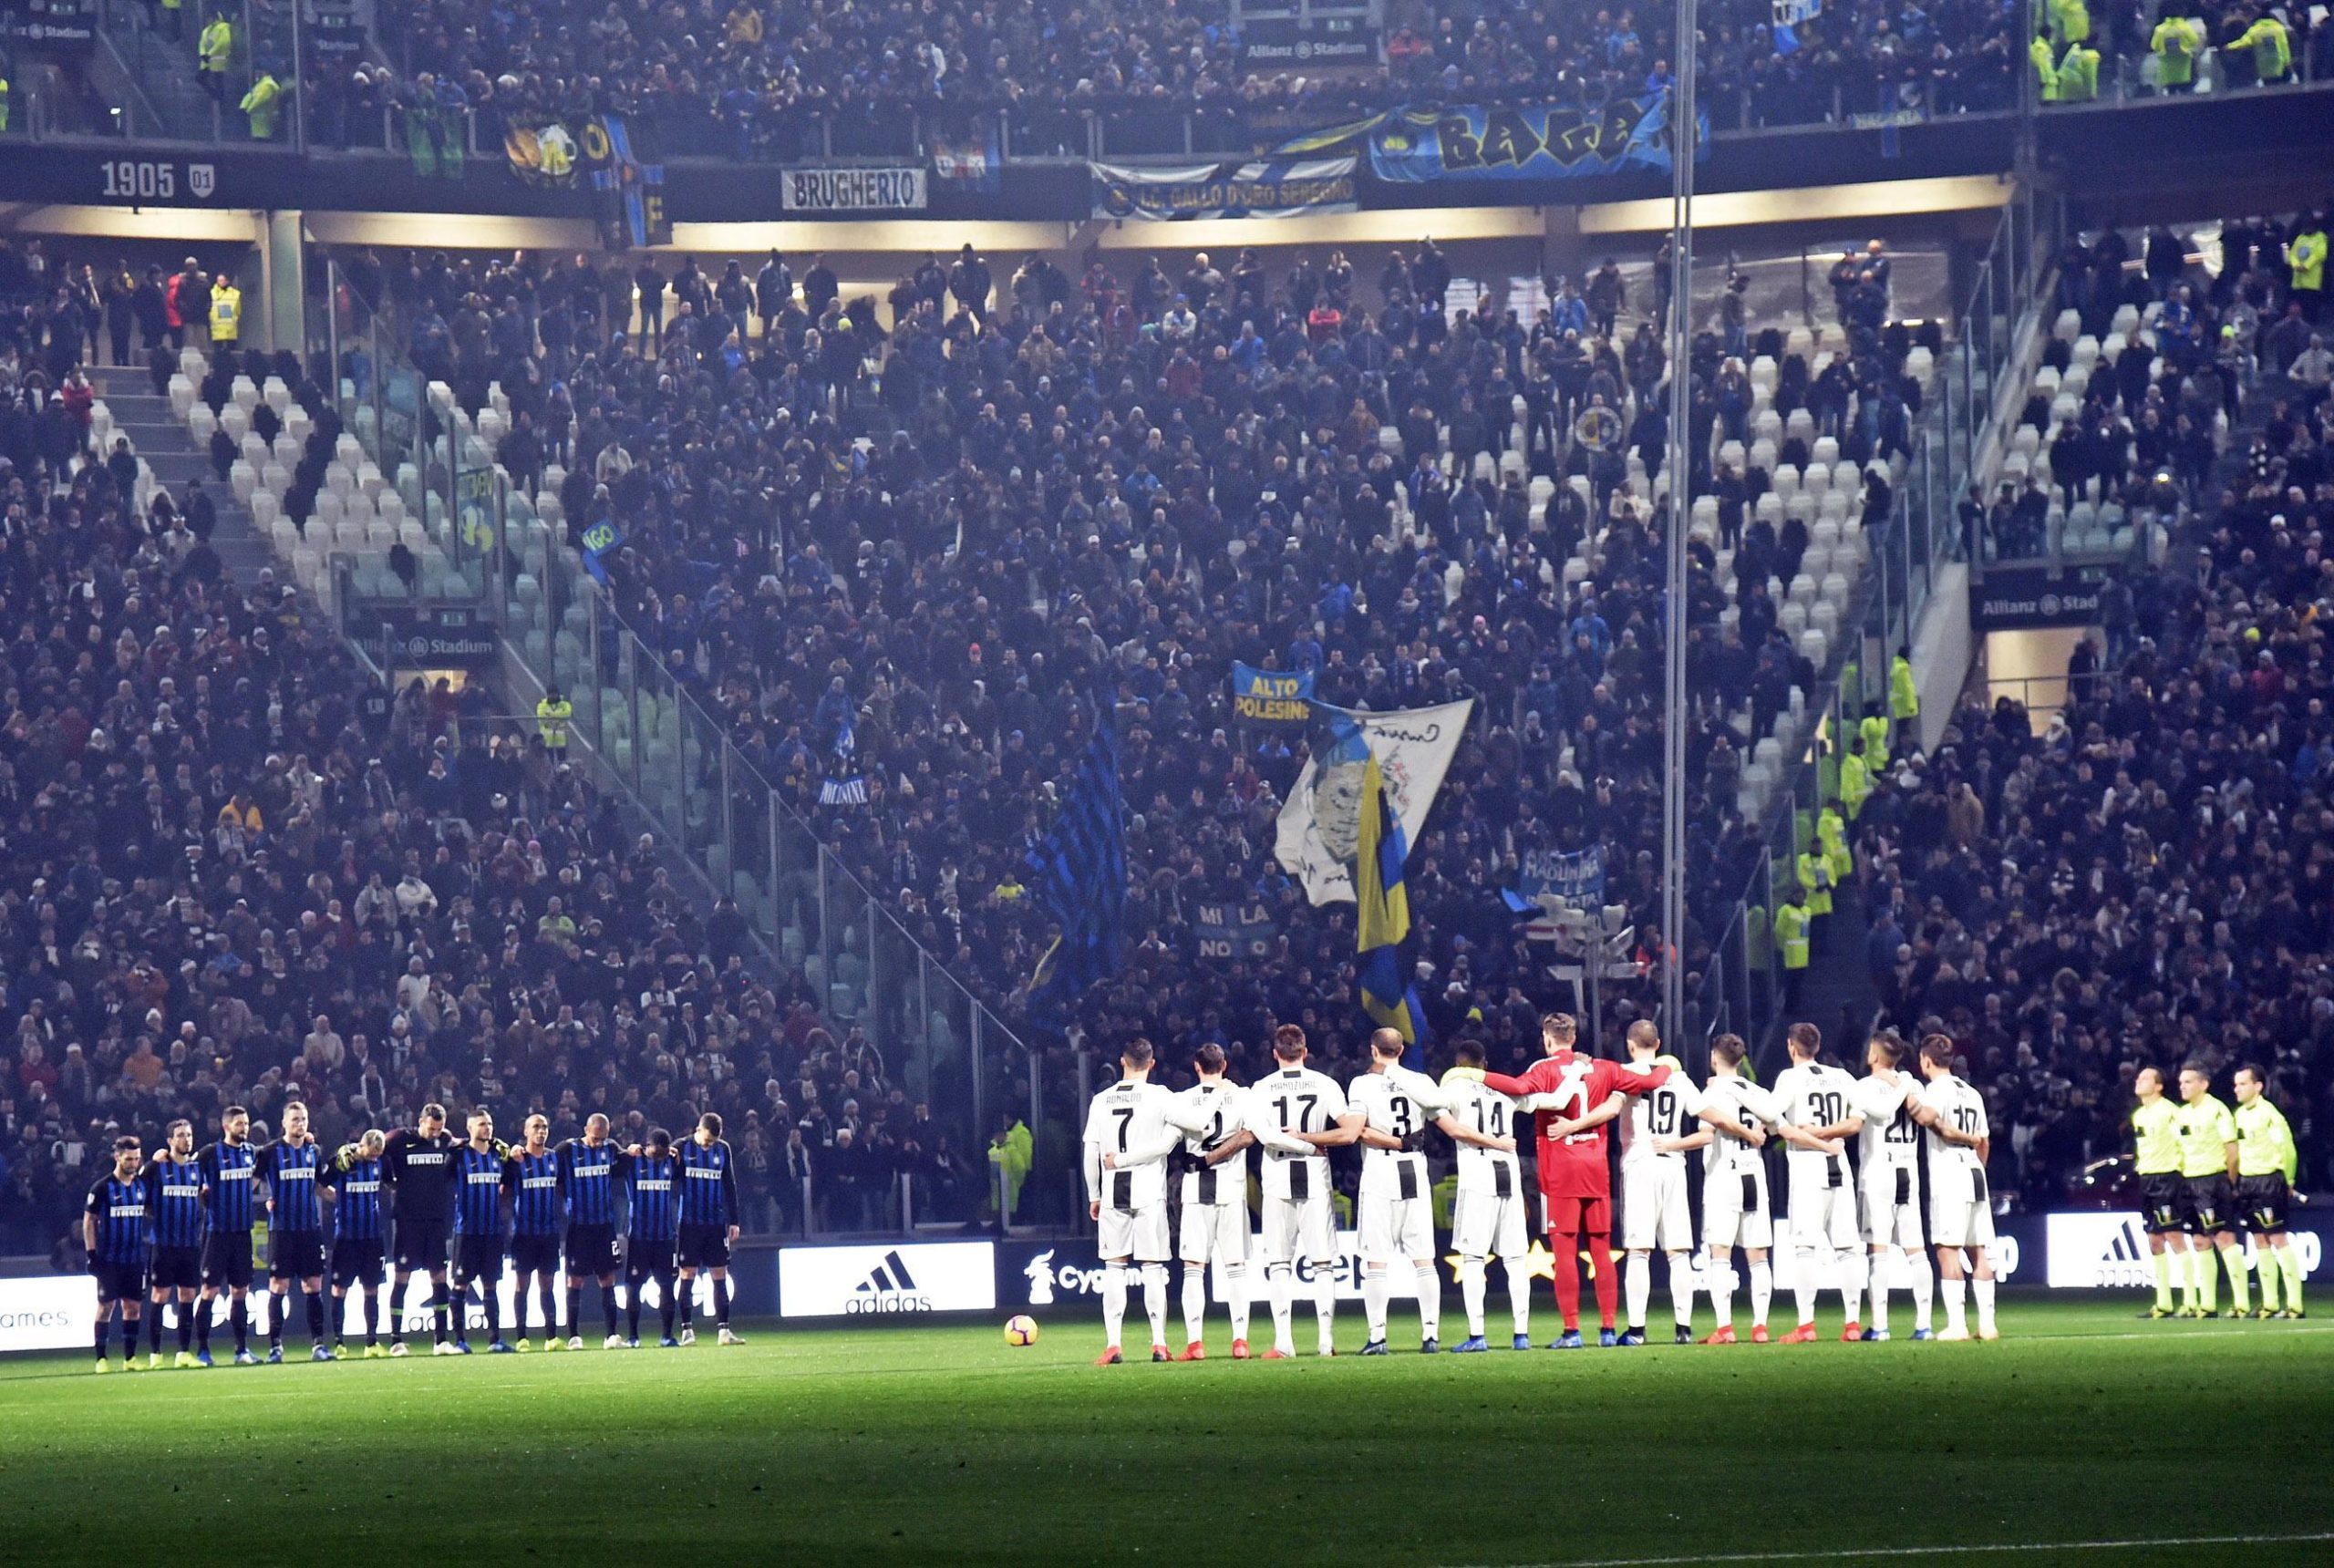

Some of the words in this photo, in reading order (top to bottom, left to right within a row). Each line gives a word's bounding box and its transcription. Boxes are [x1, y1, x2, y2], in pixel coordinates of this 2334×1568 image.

[1313, 43, 1367, 55] Stadium
[101, 161, 175, 198] 1905
[192, 170, 211, 189] 01
[793, 170, 914, 207] BRUGHERIO
[1983, 601, 2037, 614] Allianz
[2063, 595, 2097, 610] Stad
[430, 640, 492, 654] Stadium
[1251, 676, 1298, 696] ALTO
[1106, 1092, 1142, 1105] RONALDO
[1272, 1094, 1318, 1134] 17
[1640, 1089, 1677, 1135] 19
[1808, 1091, 1843, 1128] 30
[1112, 1108, 1134, 1153] 7
[1390, 1096, 1411, 1139] 3
[1471, 1097, 1505, 1138] 14
[845, 1293, 933, 1314] adidas
